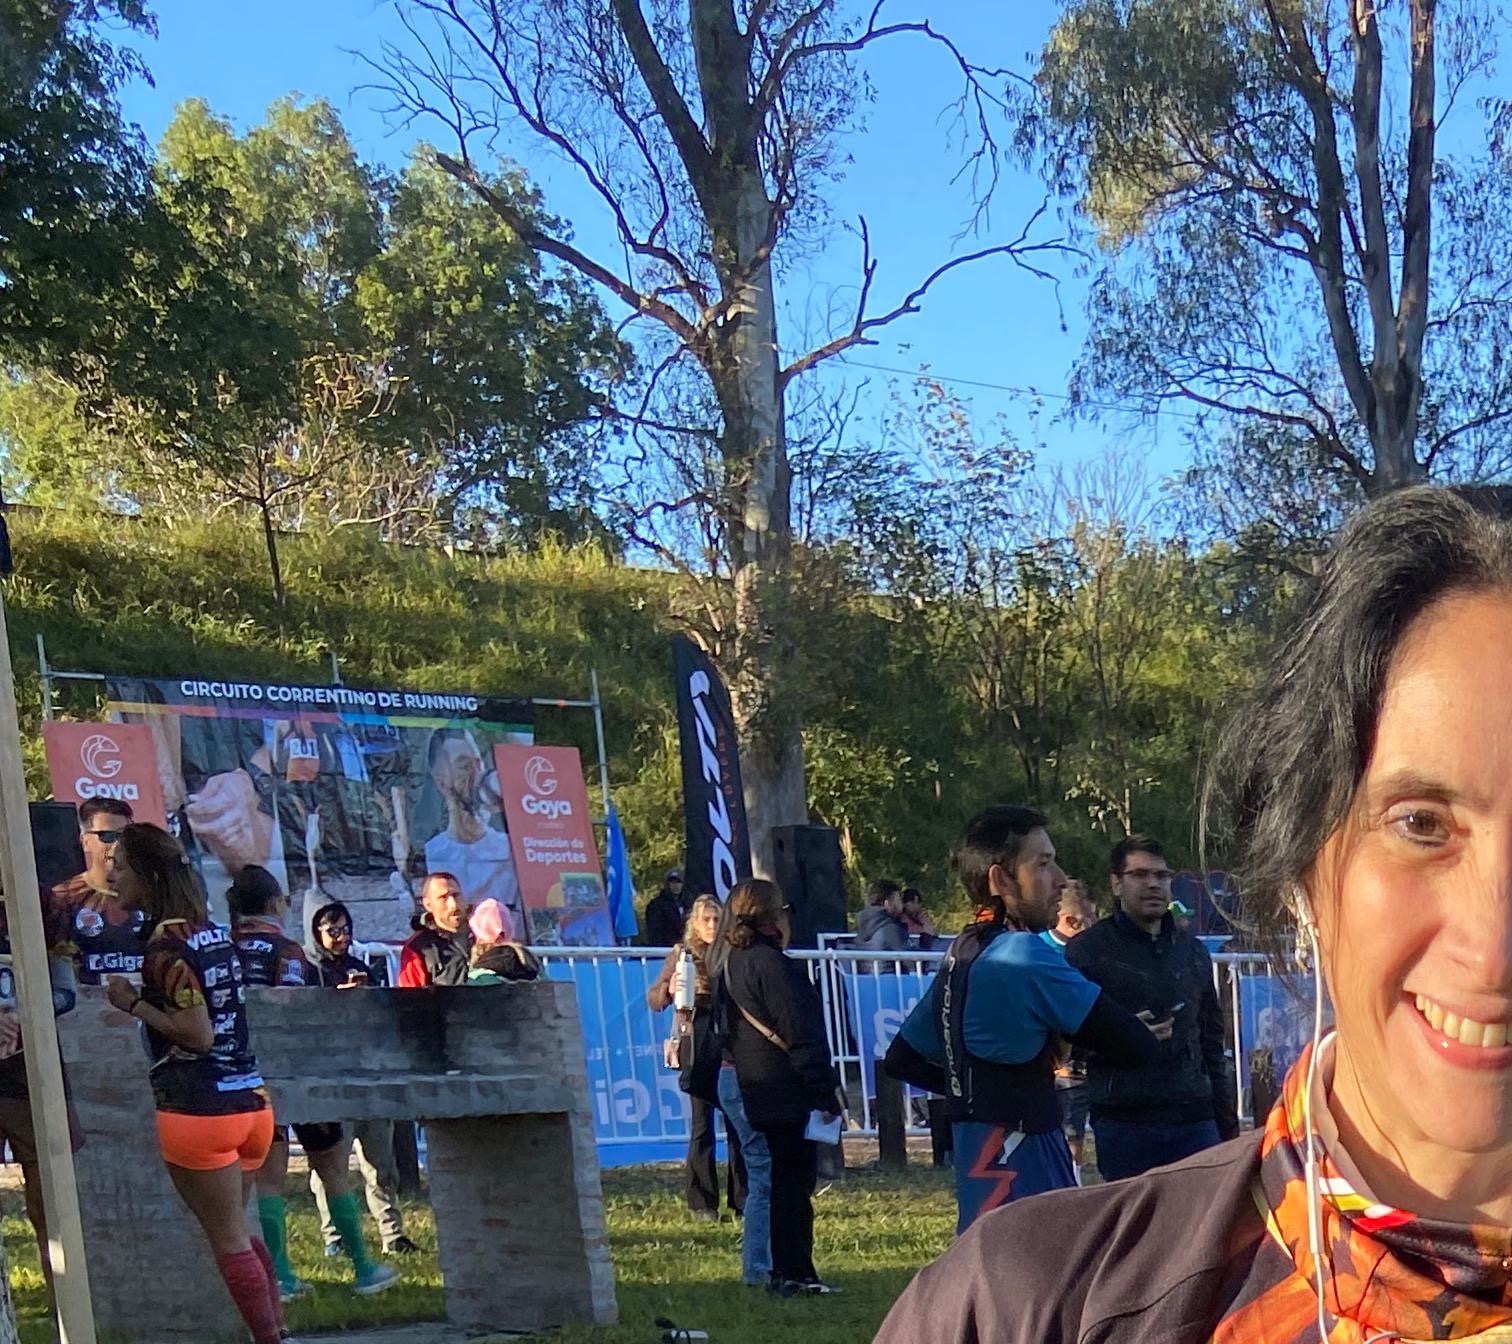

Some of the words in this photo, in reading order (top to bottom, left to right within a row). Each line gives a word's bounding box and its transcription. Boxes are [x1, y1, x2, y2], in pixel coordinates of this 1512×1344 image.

[180, 680, 263, 700] CIRCUITO
[266, 685, 376, 707] CORRENTINO
[375, 692, 403, 708] DE
[404, 695, 478, 712] RUNNING
[75, 777, 139, 800] Goya
[521, 794, 573, 819] Goya
[522, 836, 569, 849] Dirección
[570, 838, 584, 849] de
[525, 850, 588, 866] Deportes
